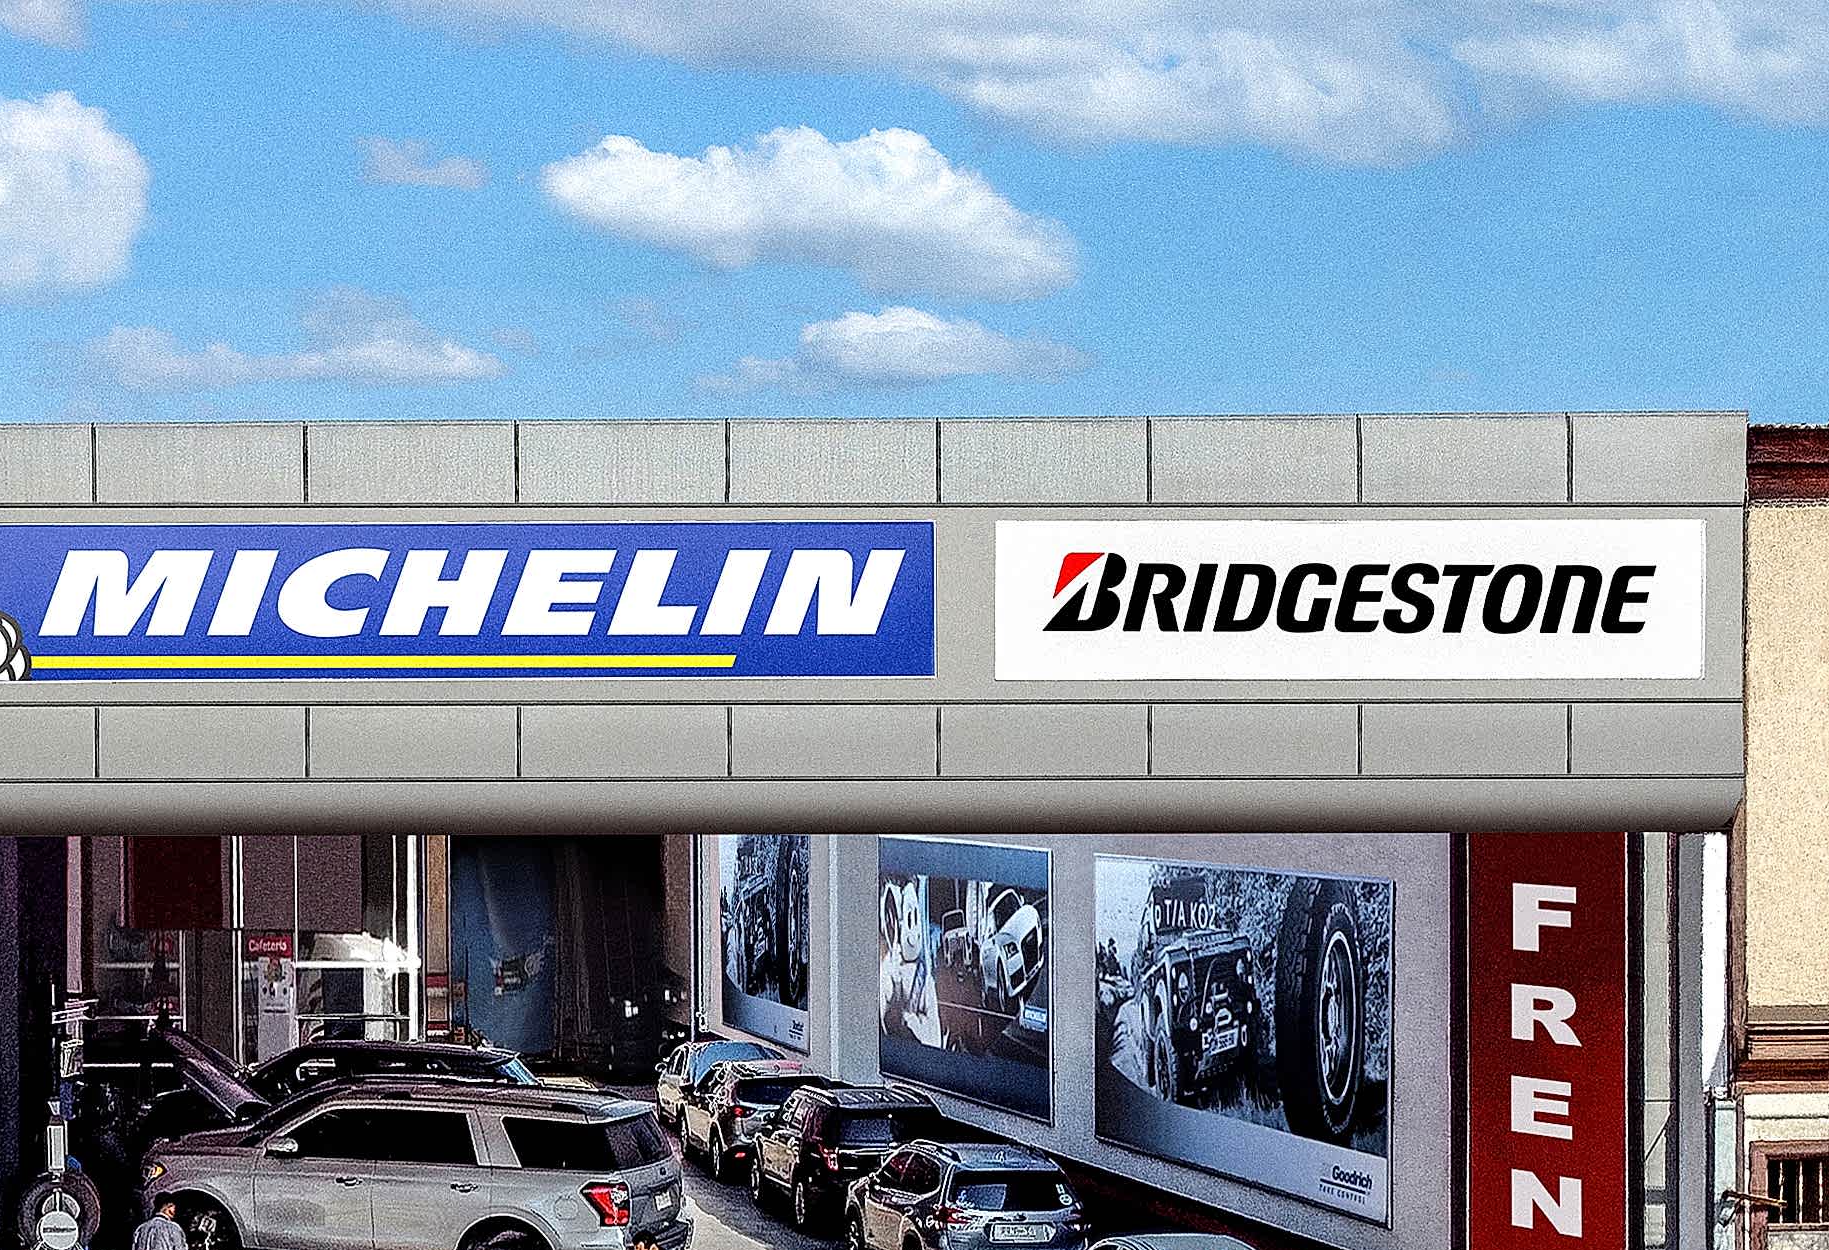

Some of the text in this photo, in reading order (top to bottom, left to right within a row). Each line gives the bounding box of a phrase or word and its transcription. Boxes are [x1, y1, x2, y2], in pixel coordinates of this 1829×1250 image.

[37, 549, 907, 636] MICHELIN
[1043, 552, 1657, 634] BRIDGESTONE
[1164, 898, 1187, 927] T/A
[1332, 1165, 1373, 1190] Goodrich
